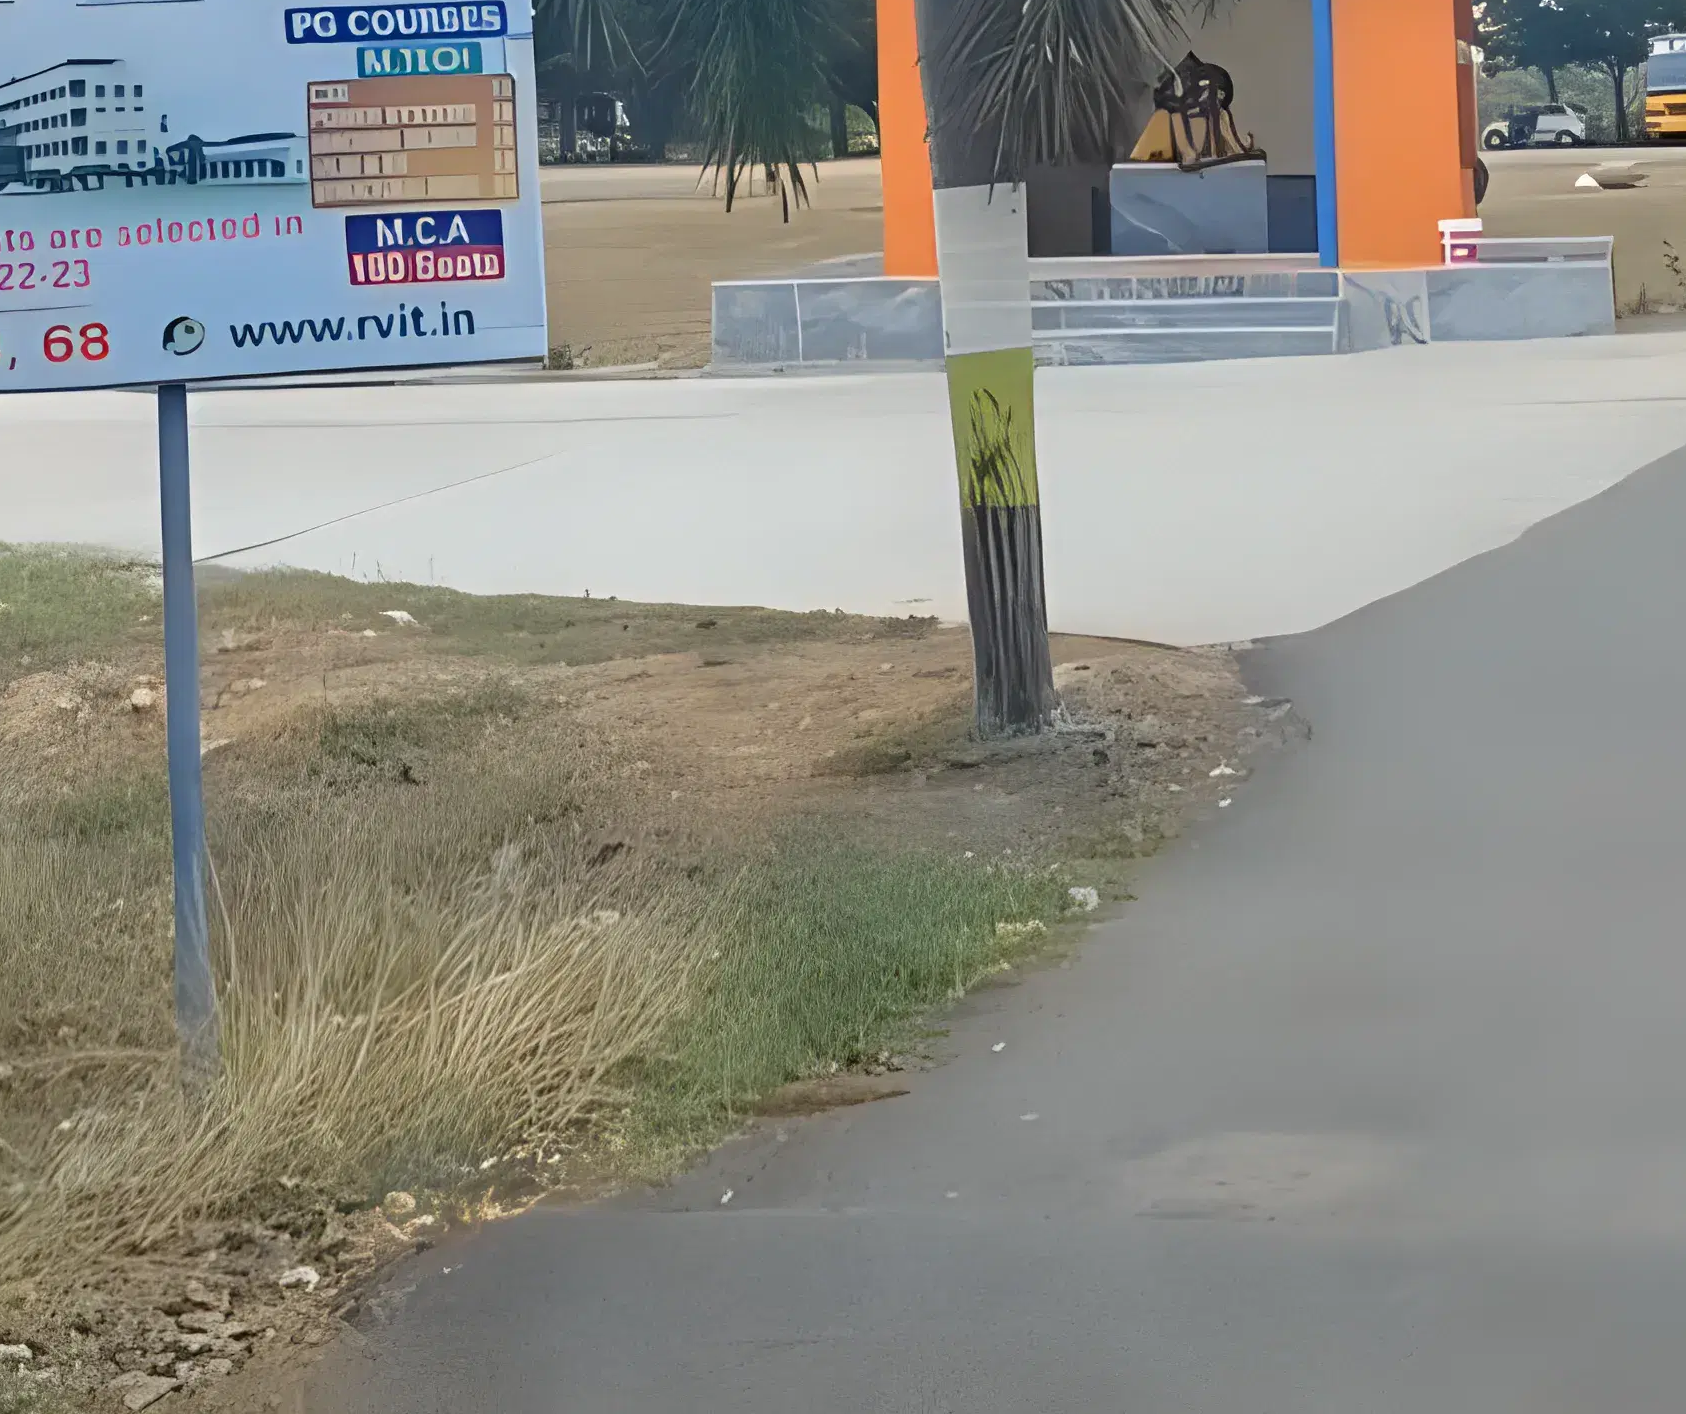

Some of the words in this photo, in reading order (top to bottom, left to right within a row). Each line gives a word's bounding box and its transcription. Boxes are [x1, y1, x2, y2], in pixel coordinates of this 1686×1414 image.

[275, 214, 304, 238] in
[42, 321, 110, 363] 68
[230, 301, 476, 349] www.rvit.in
